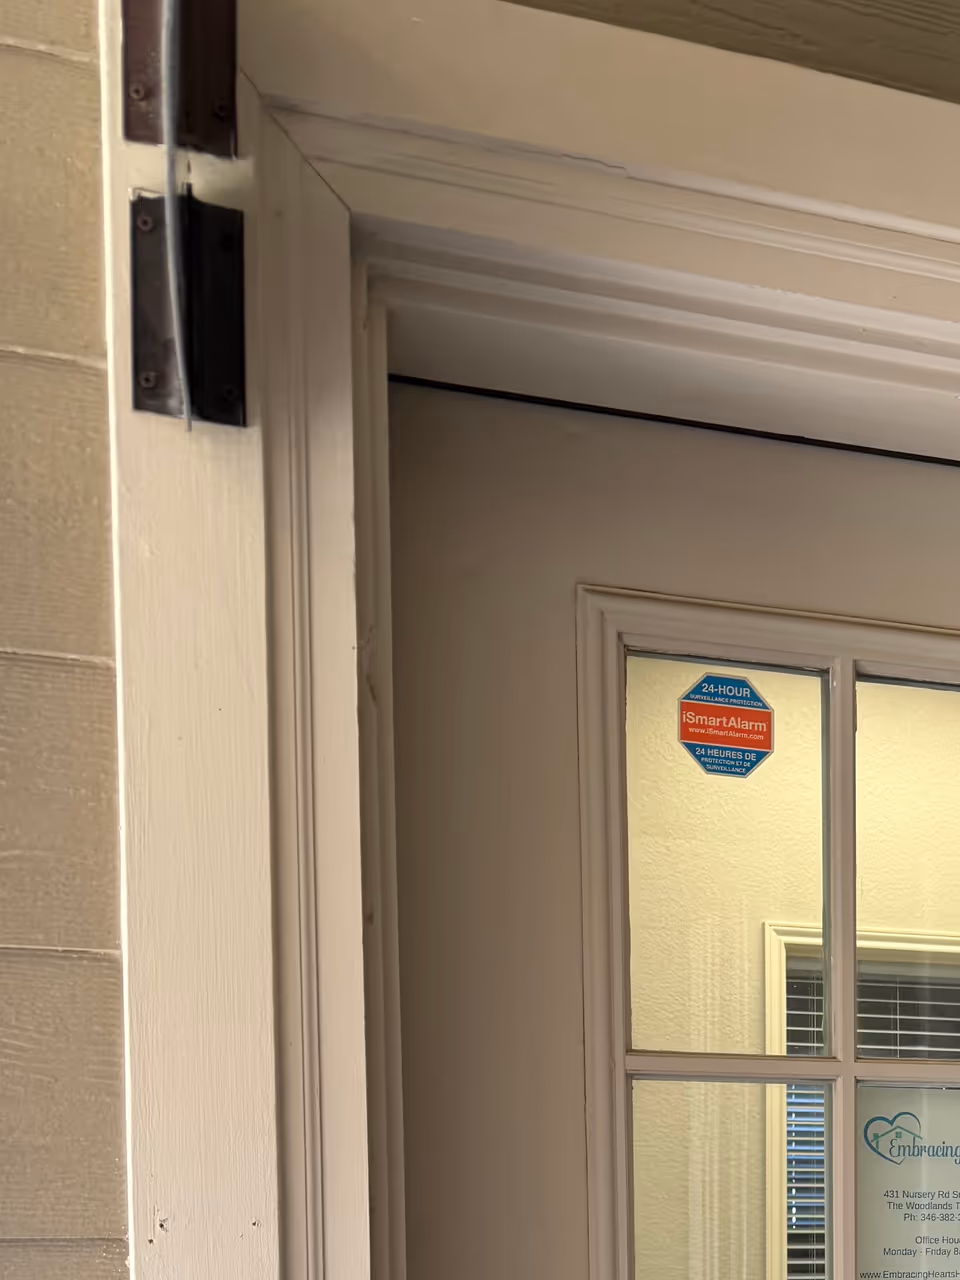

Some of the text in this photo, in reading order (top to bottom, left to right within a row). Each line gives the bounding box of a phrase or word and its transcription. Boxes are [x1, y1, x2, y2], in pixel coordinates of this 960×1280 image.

[702, 683, 751, 697] 24-HOUR
[690, 694, 763, 707] SURVEILLANCE PROTECTION
[682, 711, 766, 732] iSmartAlarm
[689, 727, 764, 740] www.iSmartAlarm.com
[707, 748, 743, 760] HEURES
[744, 753, 757, 761] DE
[701, 757, 735, 765] PROTECTION
[706, 764, 746, 773] SURVEILLANCE
[883, 1190, 899, 1198] 431
[902, 1190, 936, 1200] Nursery
[938, 1190, 950, 1199] Rd
[887, 1202, 903, 1210] The
[906, 1201, 952, 1210] Woodlands
[904, 1213, 918, 1221] Ph:
[915, 1236, 939, 1244] Office
[883, 1248, 917, 1257] Monday
[925, 1248, 951, 1257] Friday
